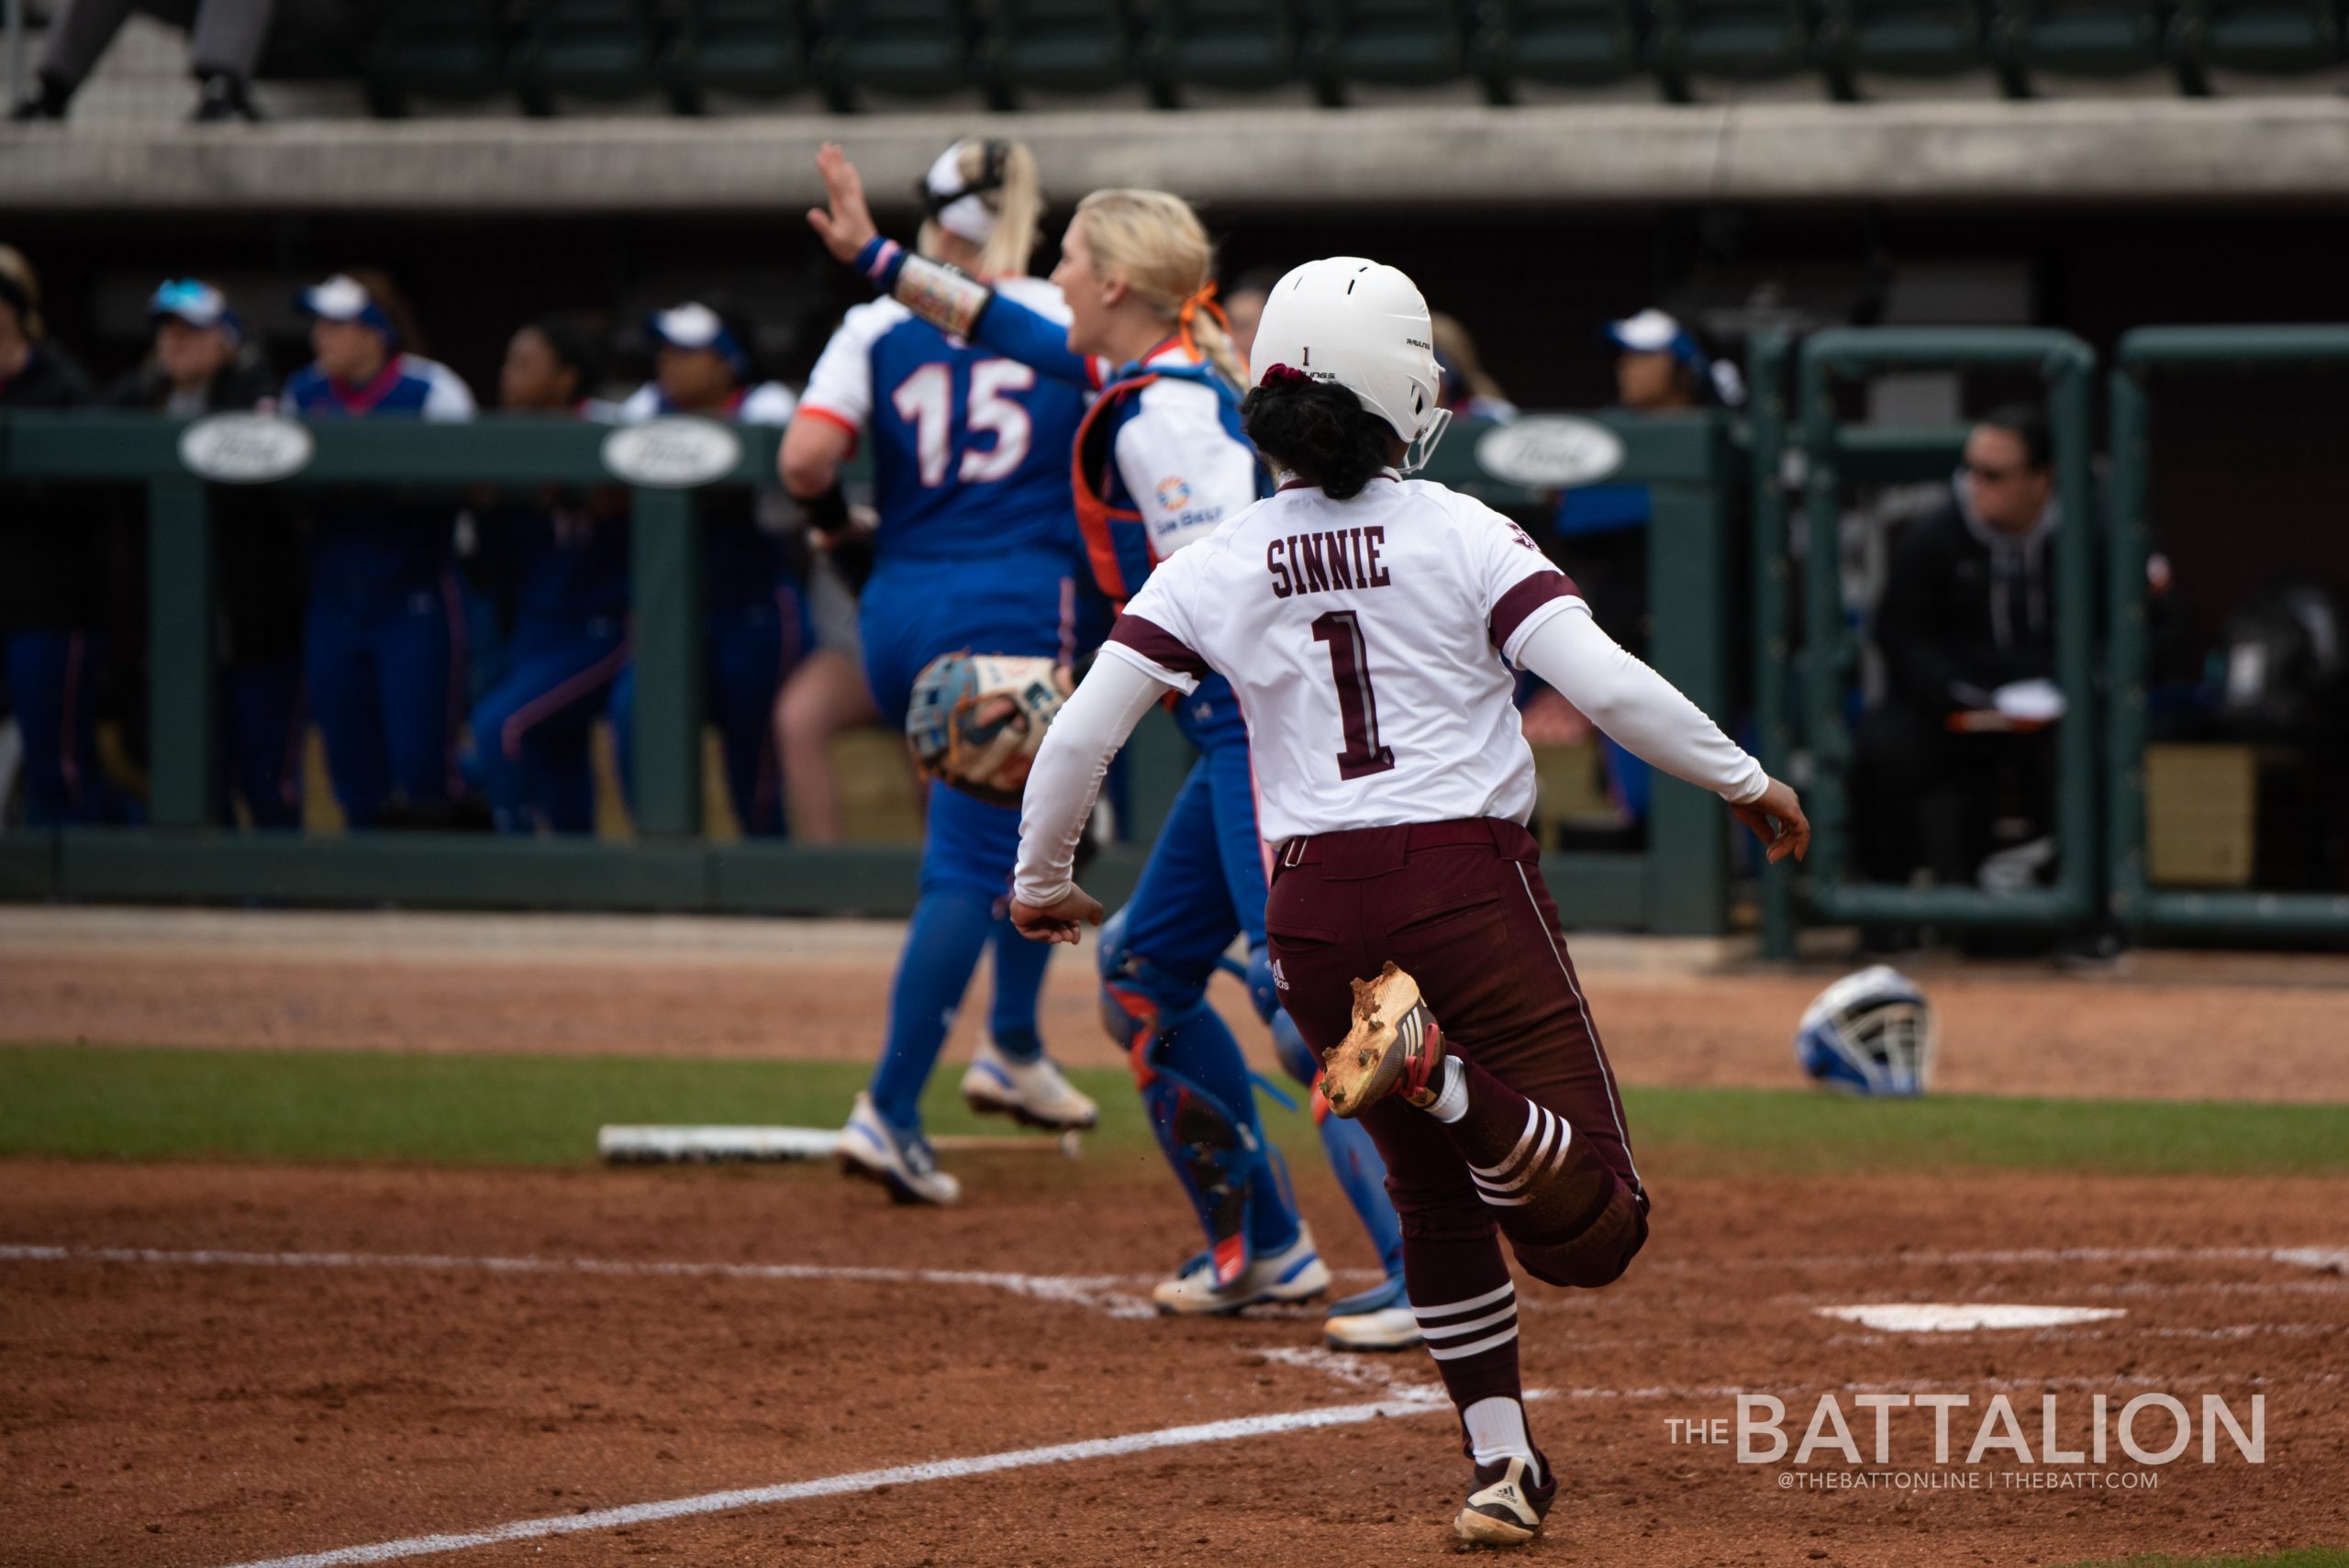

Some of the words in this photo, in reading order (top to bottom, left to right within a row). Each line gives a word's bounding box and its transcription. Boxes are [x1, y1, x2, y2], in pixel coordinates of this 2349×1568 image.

[1302, 346, 1310, 367] 1
[891, 357, 1037, 488] 15
[1266, 525, 1391, 599] SINNIE
[1310, 609, 1396, 782] 1
